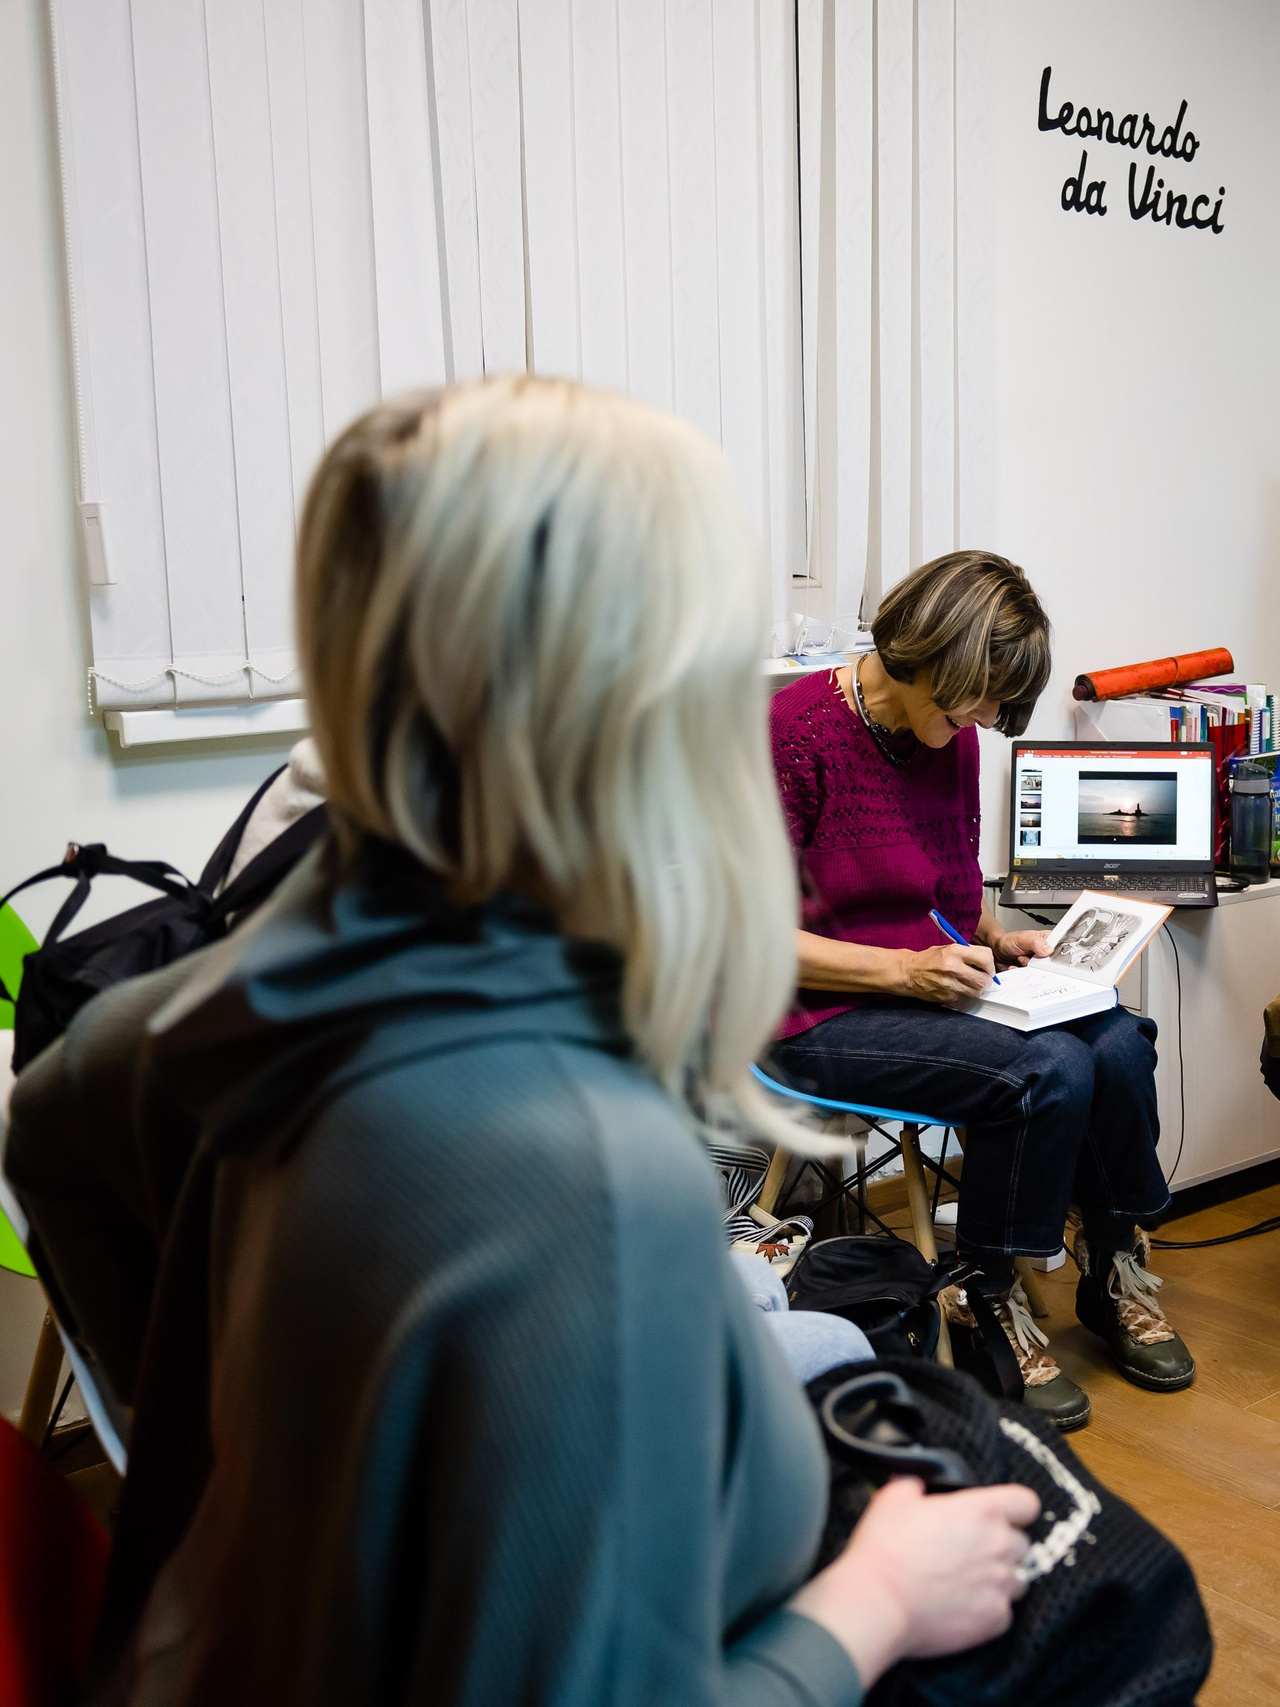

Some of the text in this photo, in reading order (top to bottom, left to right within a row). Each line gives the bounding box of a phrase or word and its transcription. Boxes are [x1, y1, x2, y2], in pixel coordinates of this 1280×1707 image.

[1038, 65, 1200, 162] Leonardo
[1061, 149, 1225, 234] da Vinci
